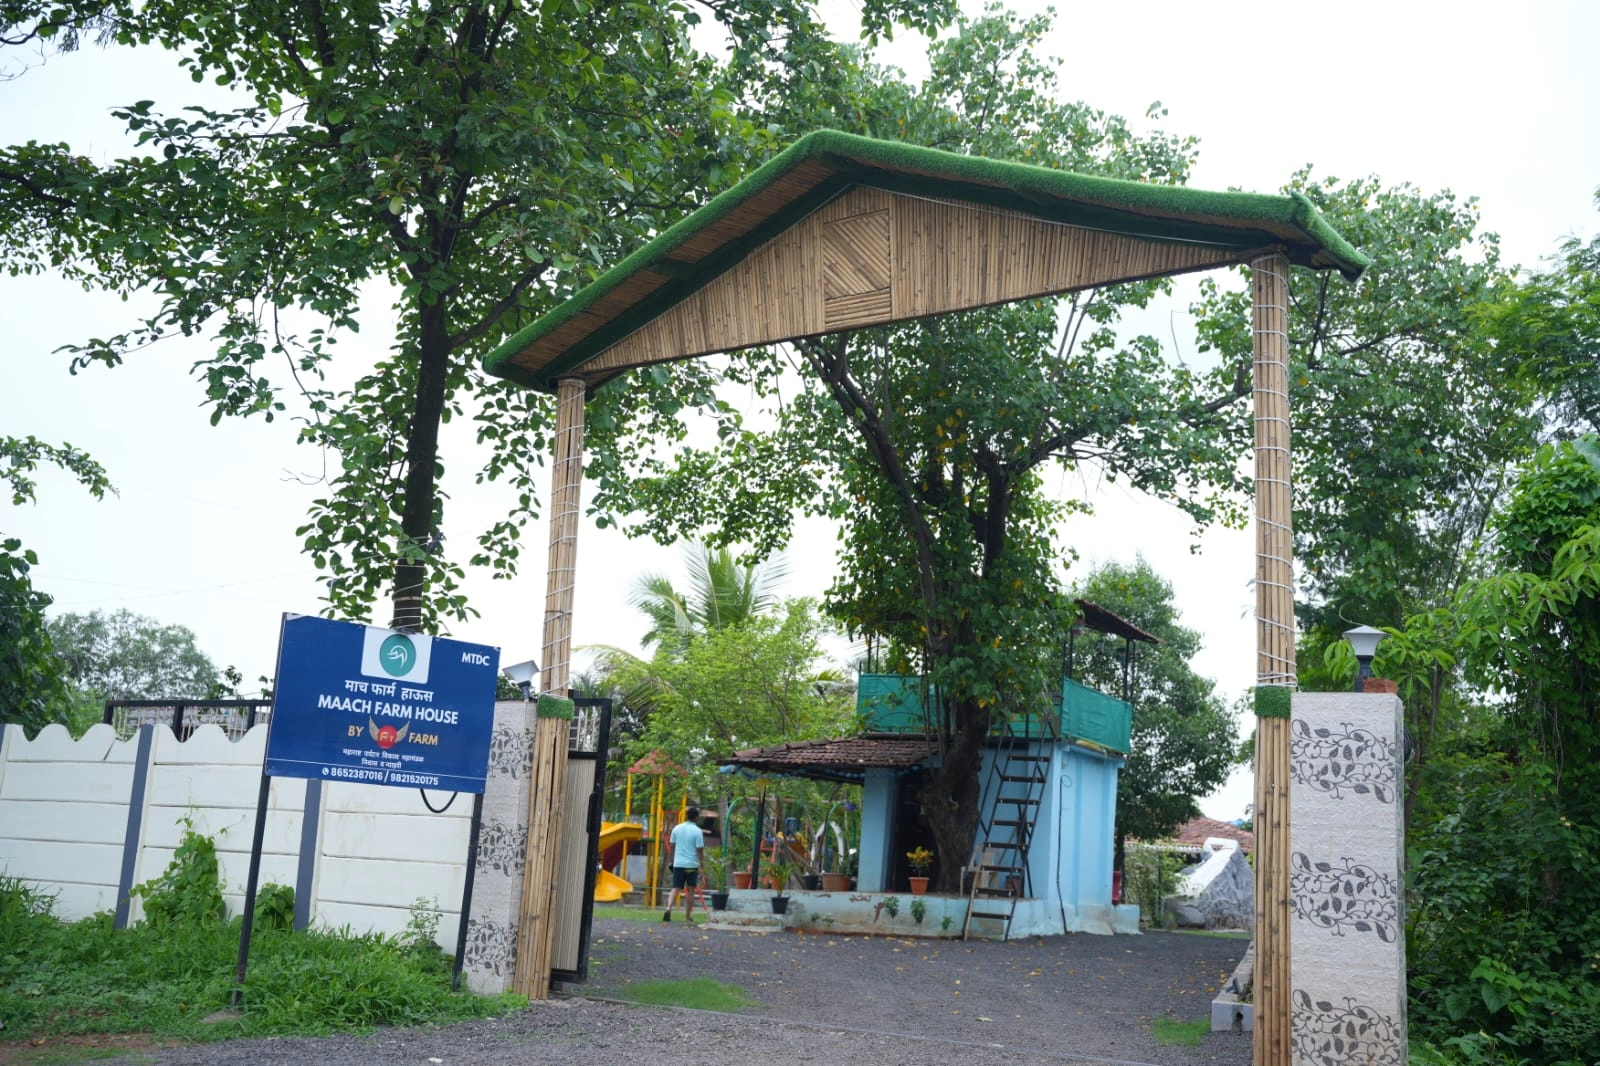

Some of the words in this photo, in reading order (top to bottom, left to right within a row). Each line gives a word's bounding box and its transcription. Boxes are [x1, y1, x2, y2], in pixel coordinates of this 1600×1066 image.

[461, 651, 490, 666] MTDC
[344, 680, 369, 694] माच
[371, 682, 397, 697] फार्म
[401, 687, 434, 702] हाऊस
[317, 694, 372, 714] MAACH
[374, 701, 412, 719] FARM
[415, 706, 459, 725] HOUSE
[347, 725, 364, 737] BY
[408, 732, 438, 745] FARM
[331, 767, 383, 780] 8652387016
[390, 773, 439, 786] 9821520175
